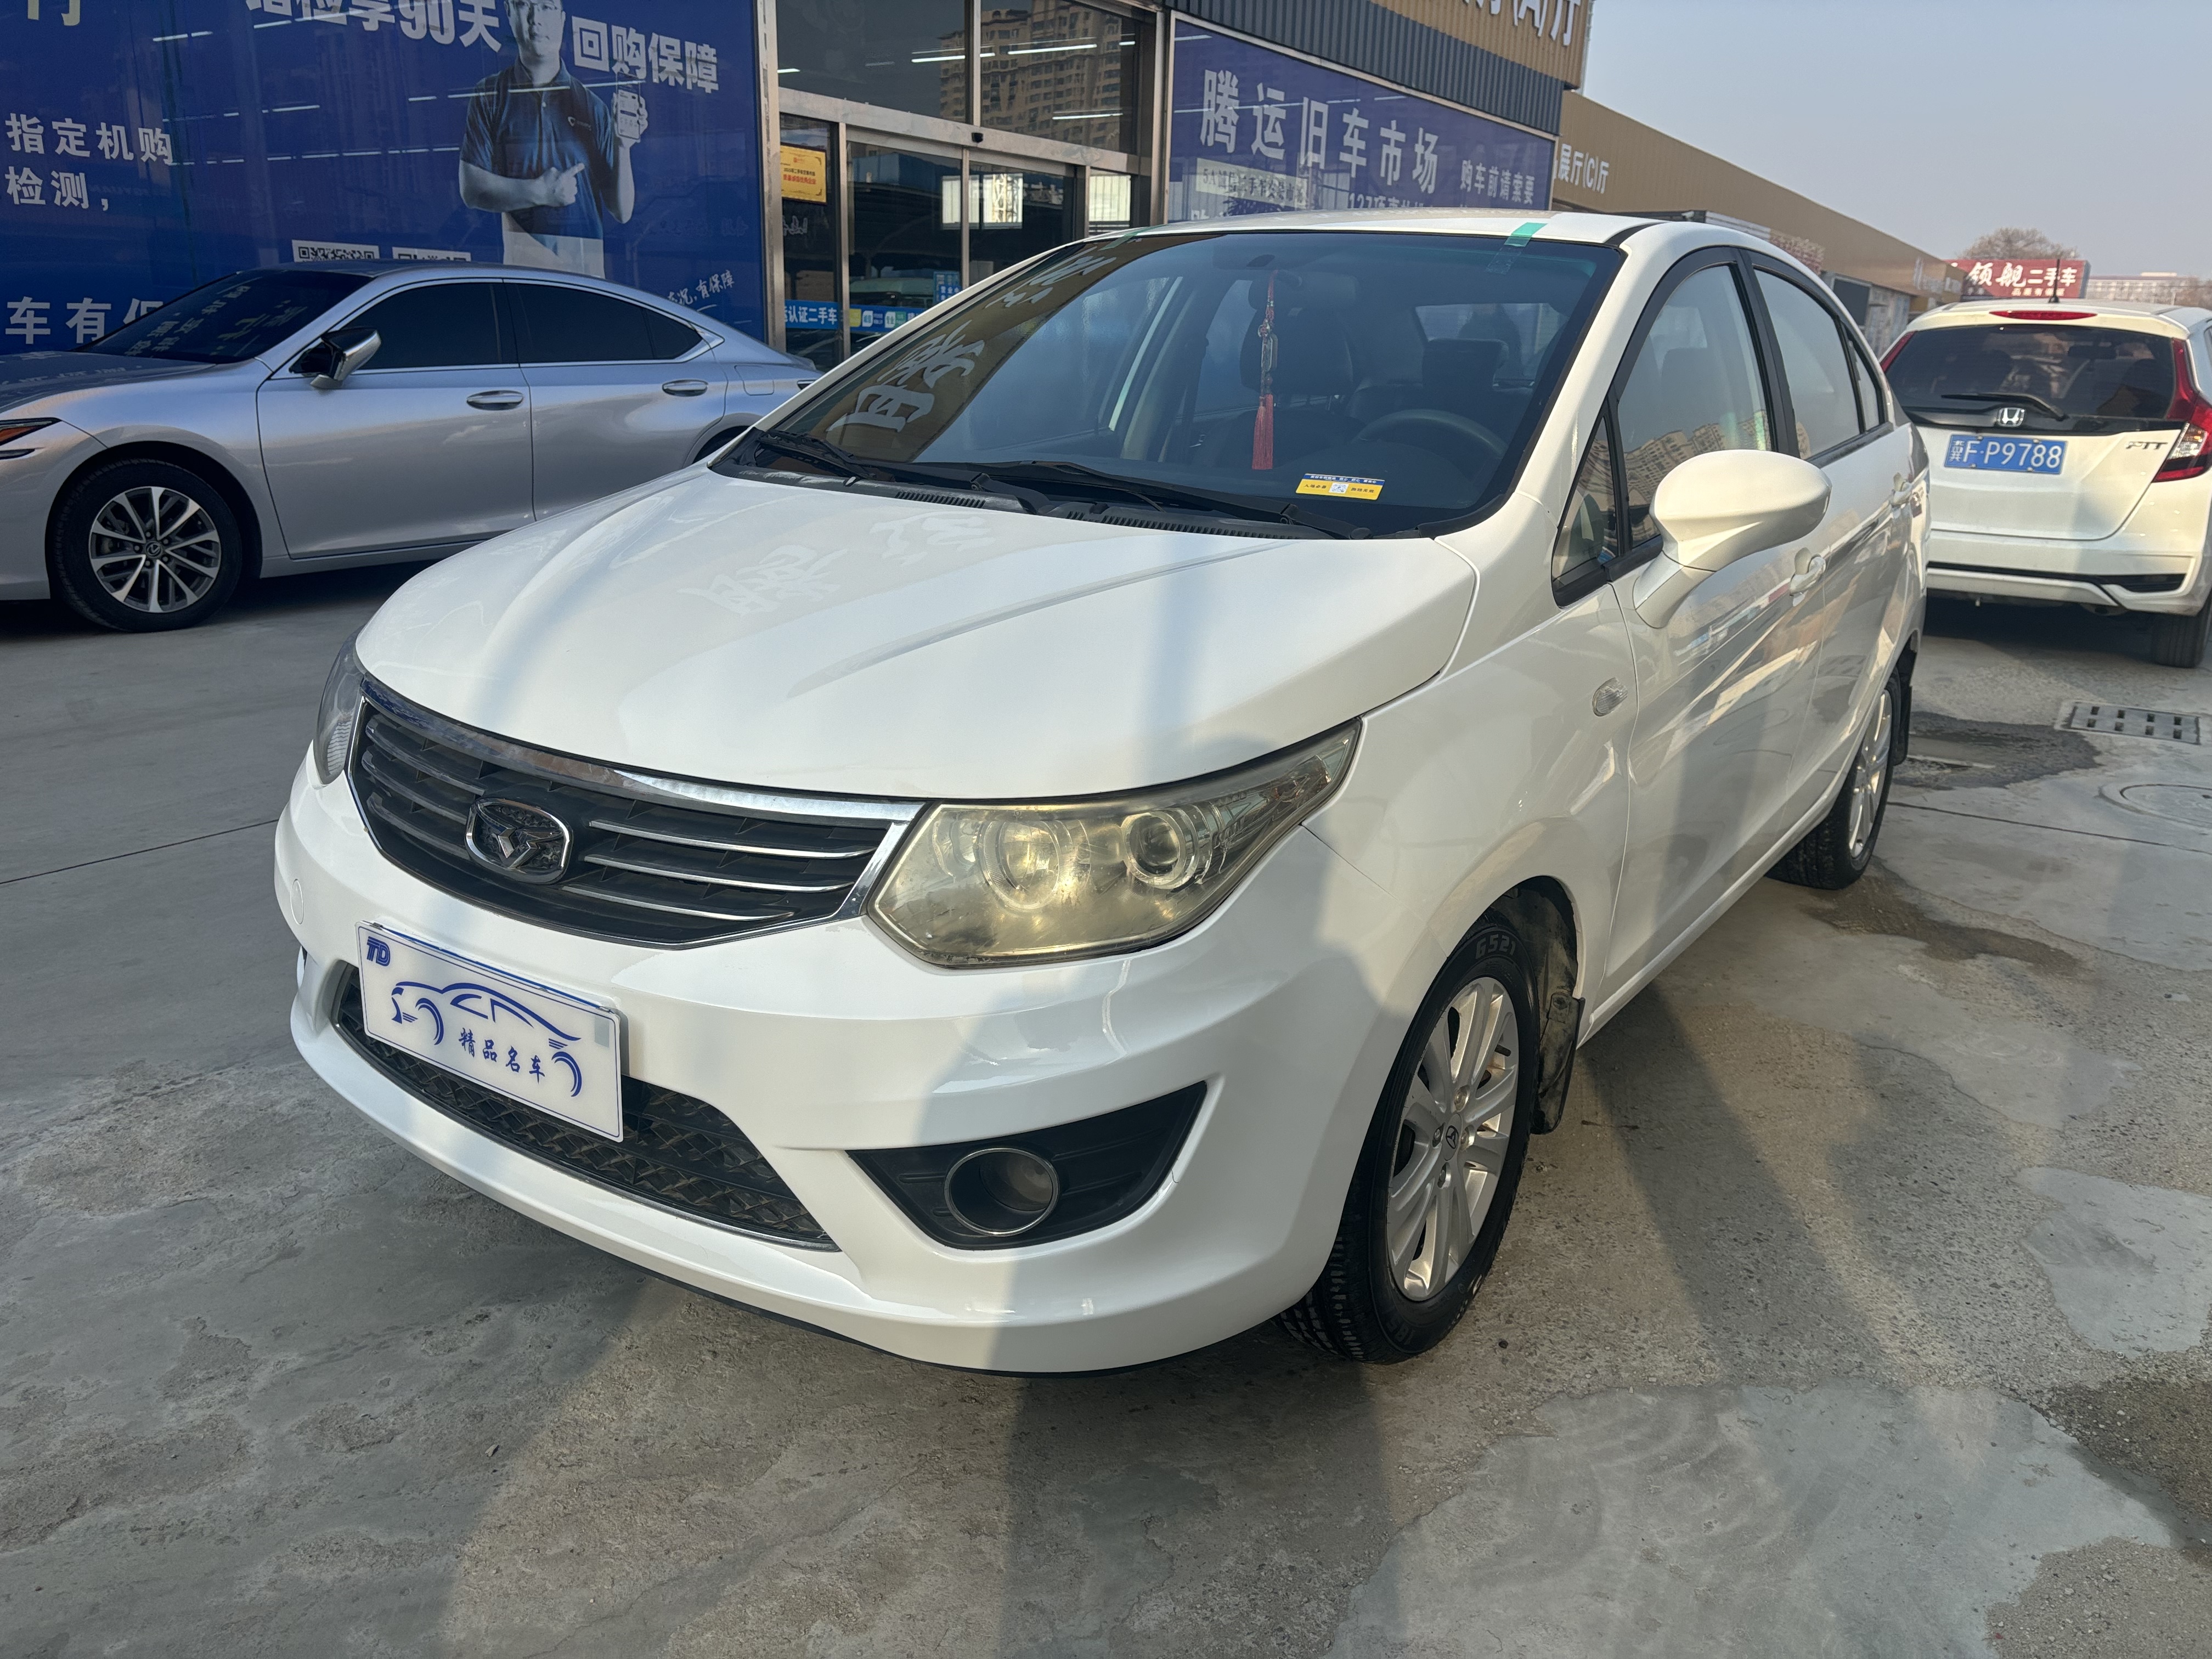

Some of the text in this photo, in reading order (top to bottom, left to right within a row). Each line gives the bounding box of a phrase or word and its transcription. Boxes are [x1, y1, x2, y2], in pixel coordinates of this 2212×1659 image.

[572, 15, 719, 94] 回购保障
[5, 113, 173, 165] 指定机购
[1199, 69, 1438, 194] 腾运旧车市场
[1460, 160, 1535, 206] 购车前请索要
[2126, 441, 2169, 450] FIT
[366, 936, 391, 967] TD
[459, 1027, 545, 1085] 精品名车
